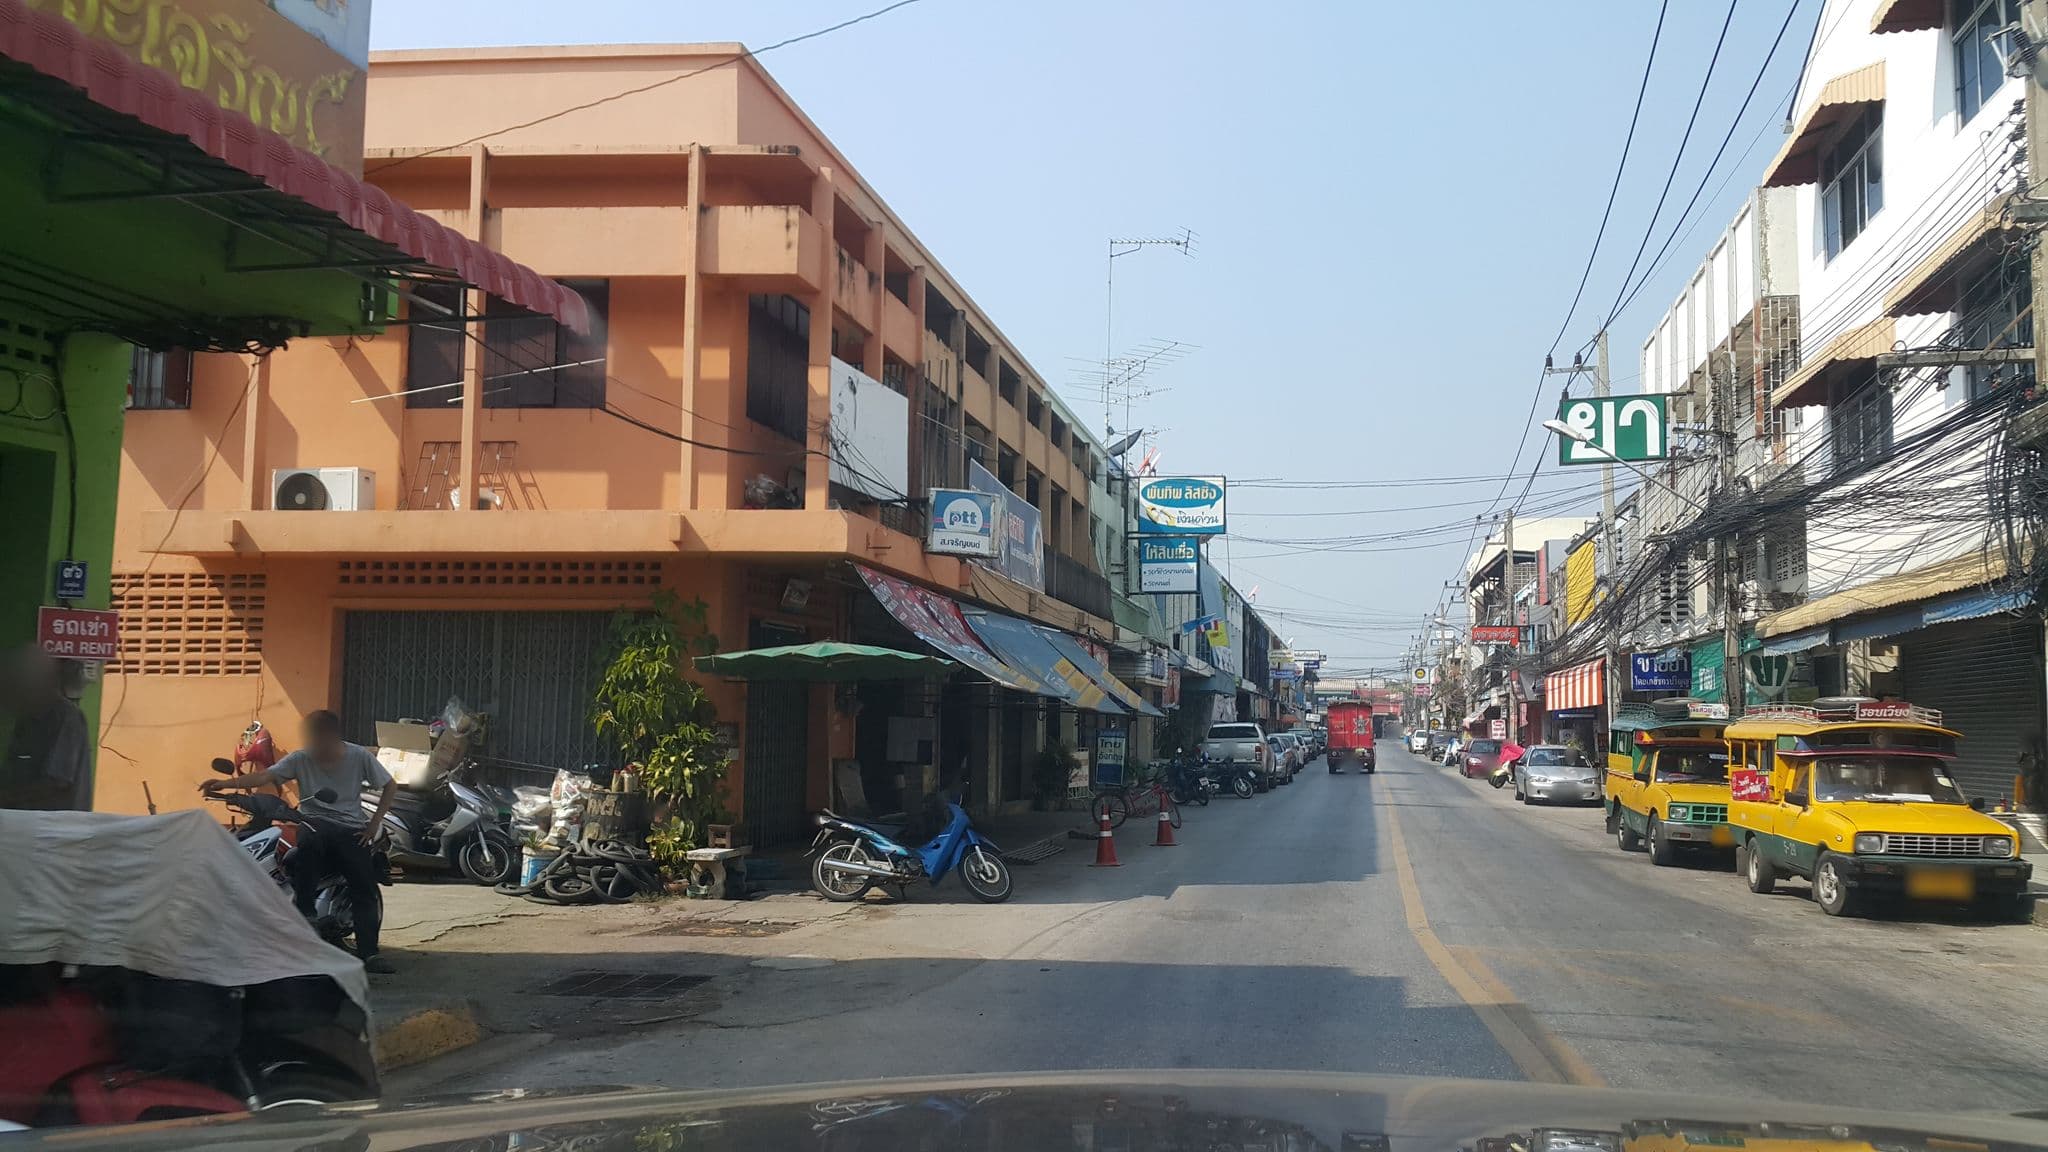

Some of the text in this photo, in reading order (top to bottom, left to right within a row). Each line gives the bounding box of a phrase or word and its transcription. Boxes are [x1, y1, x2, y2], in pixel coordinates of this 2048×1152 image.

[1566, 400, 1661, 460] ยา
[949, 510, 977, 526] ptt
[52, 615, 109, 637] รถเช่า
[44, 640, 113, 656] CAR RENT
[1860, 705, 1910, 717] รอบเวียง
